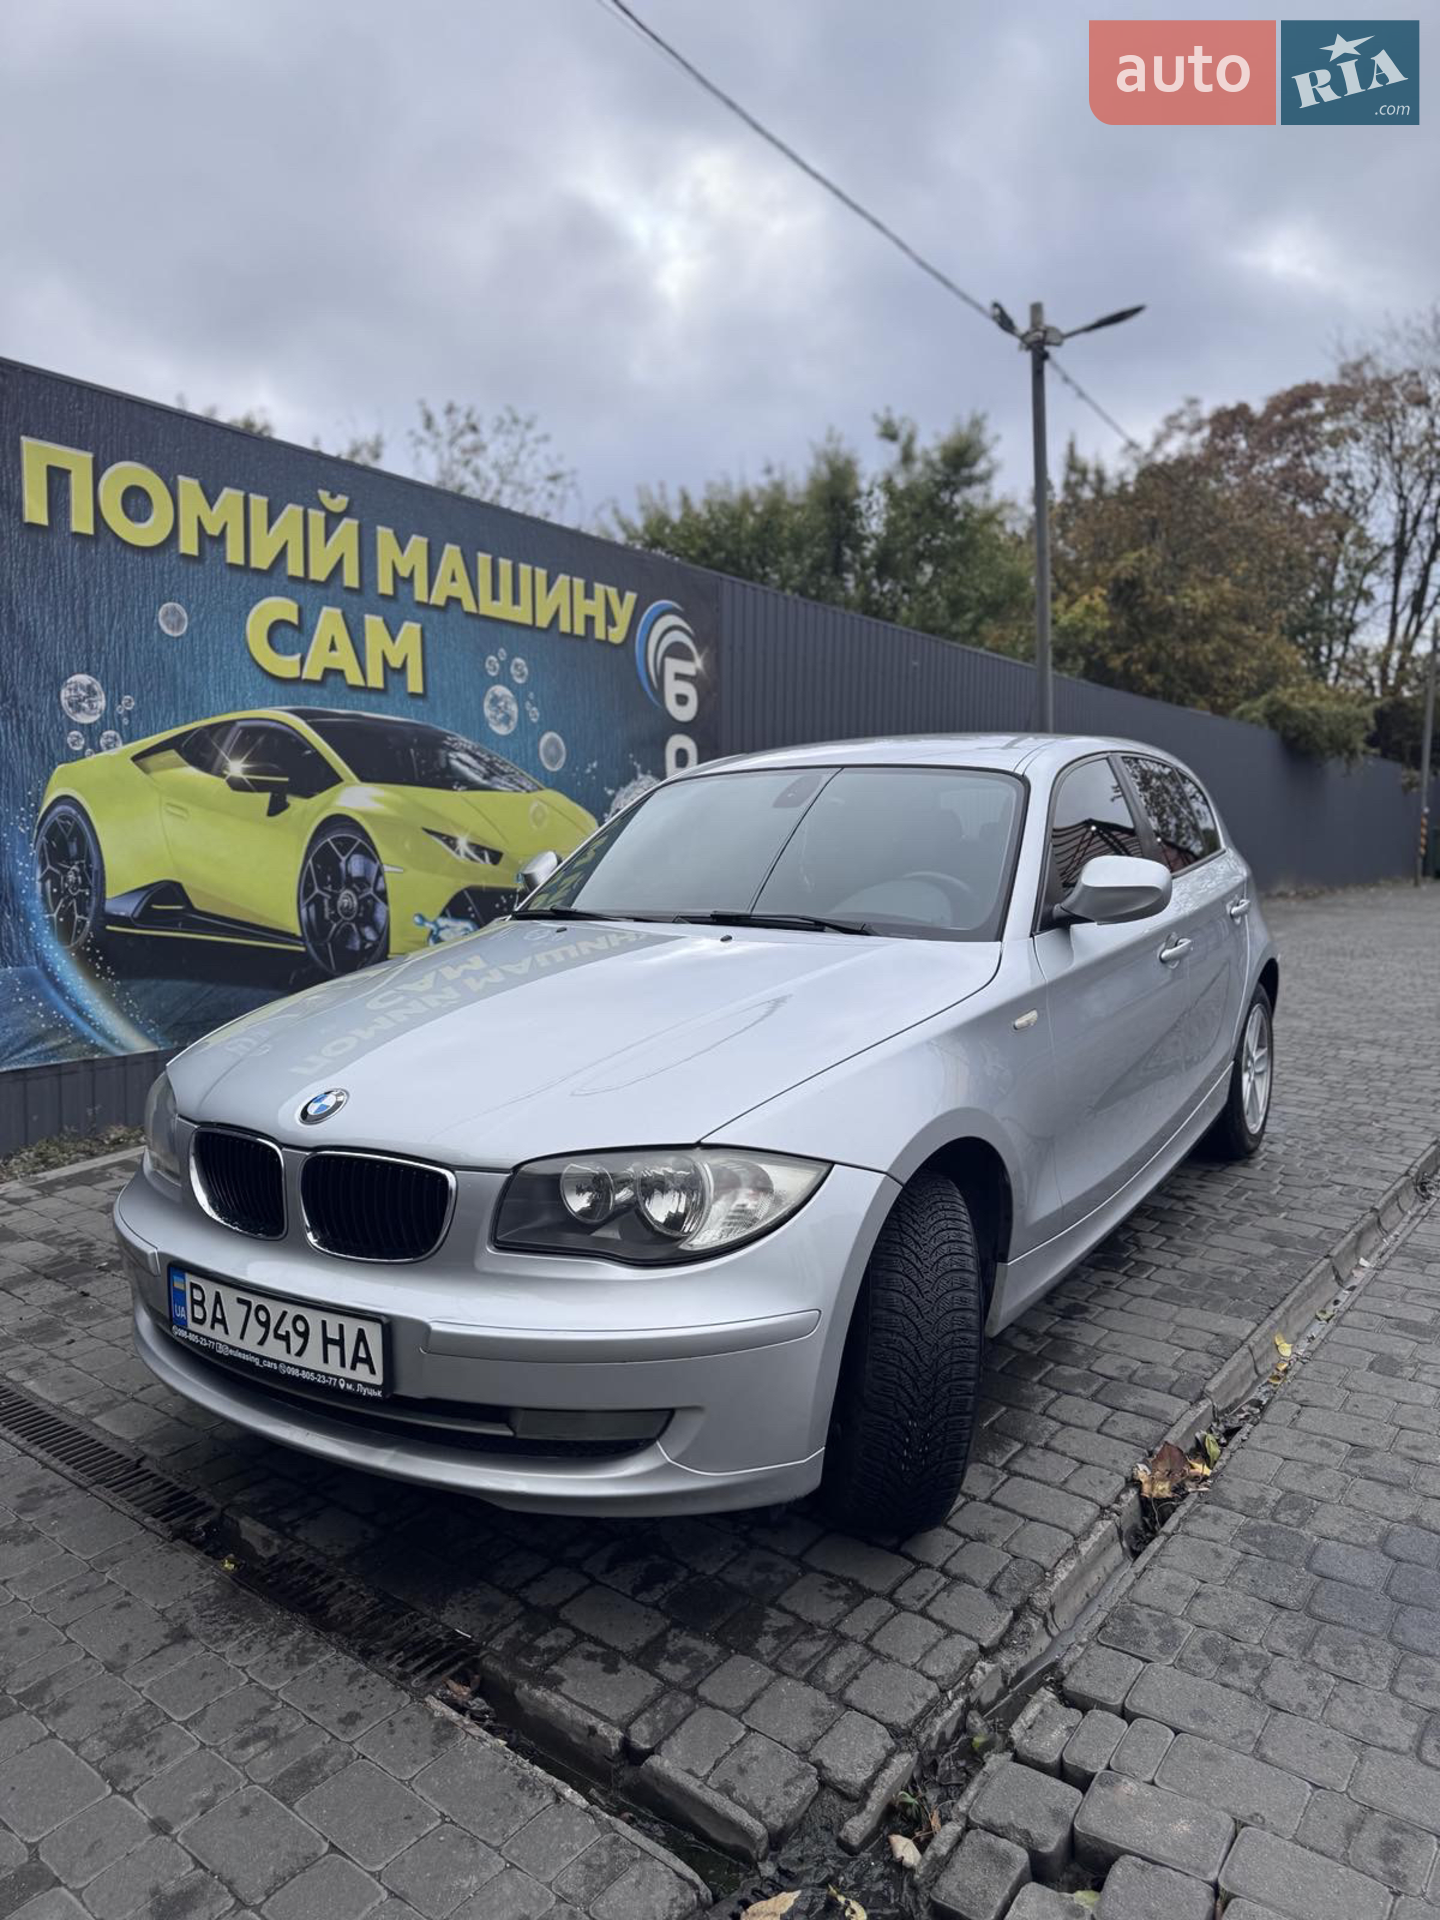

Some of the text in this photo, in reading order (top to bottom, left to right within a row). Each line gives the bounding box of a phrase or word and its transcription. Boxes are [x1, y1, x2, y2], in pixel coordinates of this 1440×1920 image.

[21, 435, 638, 645] ПОМИЙ МАШИНУ
[246, 596, 425, 695] САМ
[174, 1303, 187, 1319] UA
[236, 1297, 311, 1358] 7949
[286, 1366, 338, 1387] 098-805-23-77
